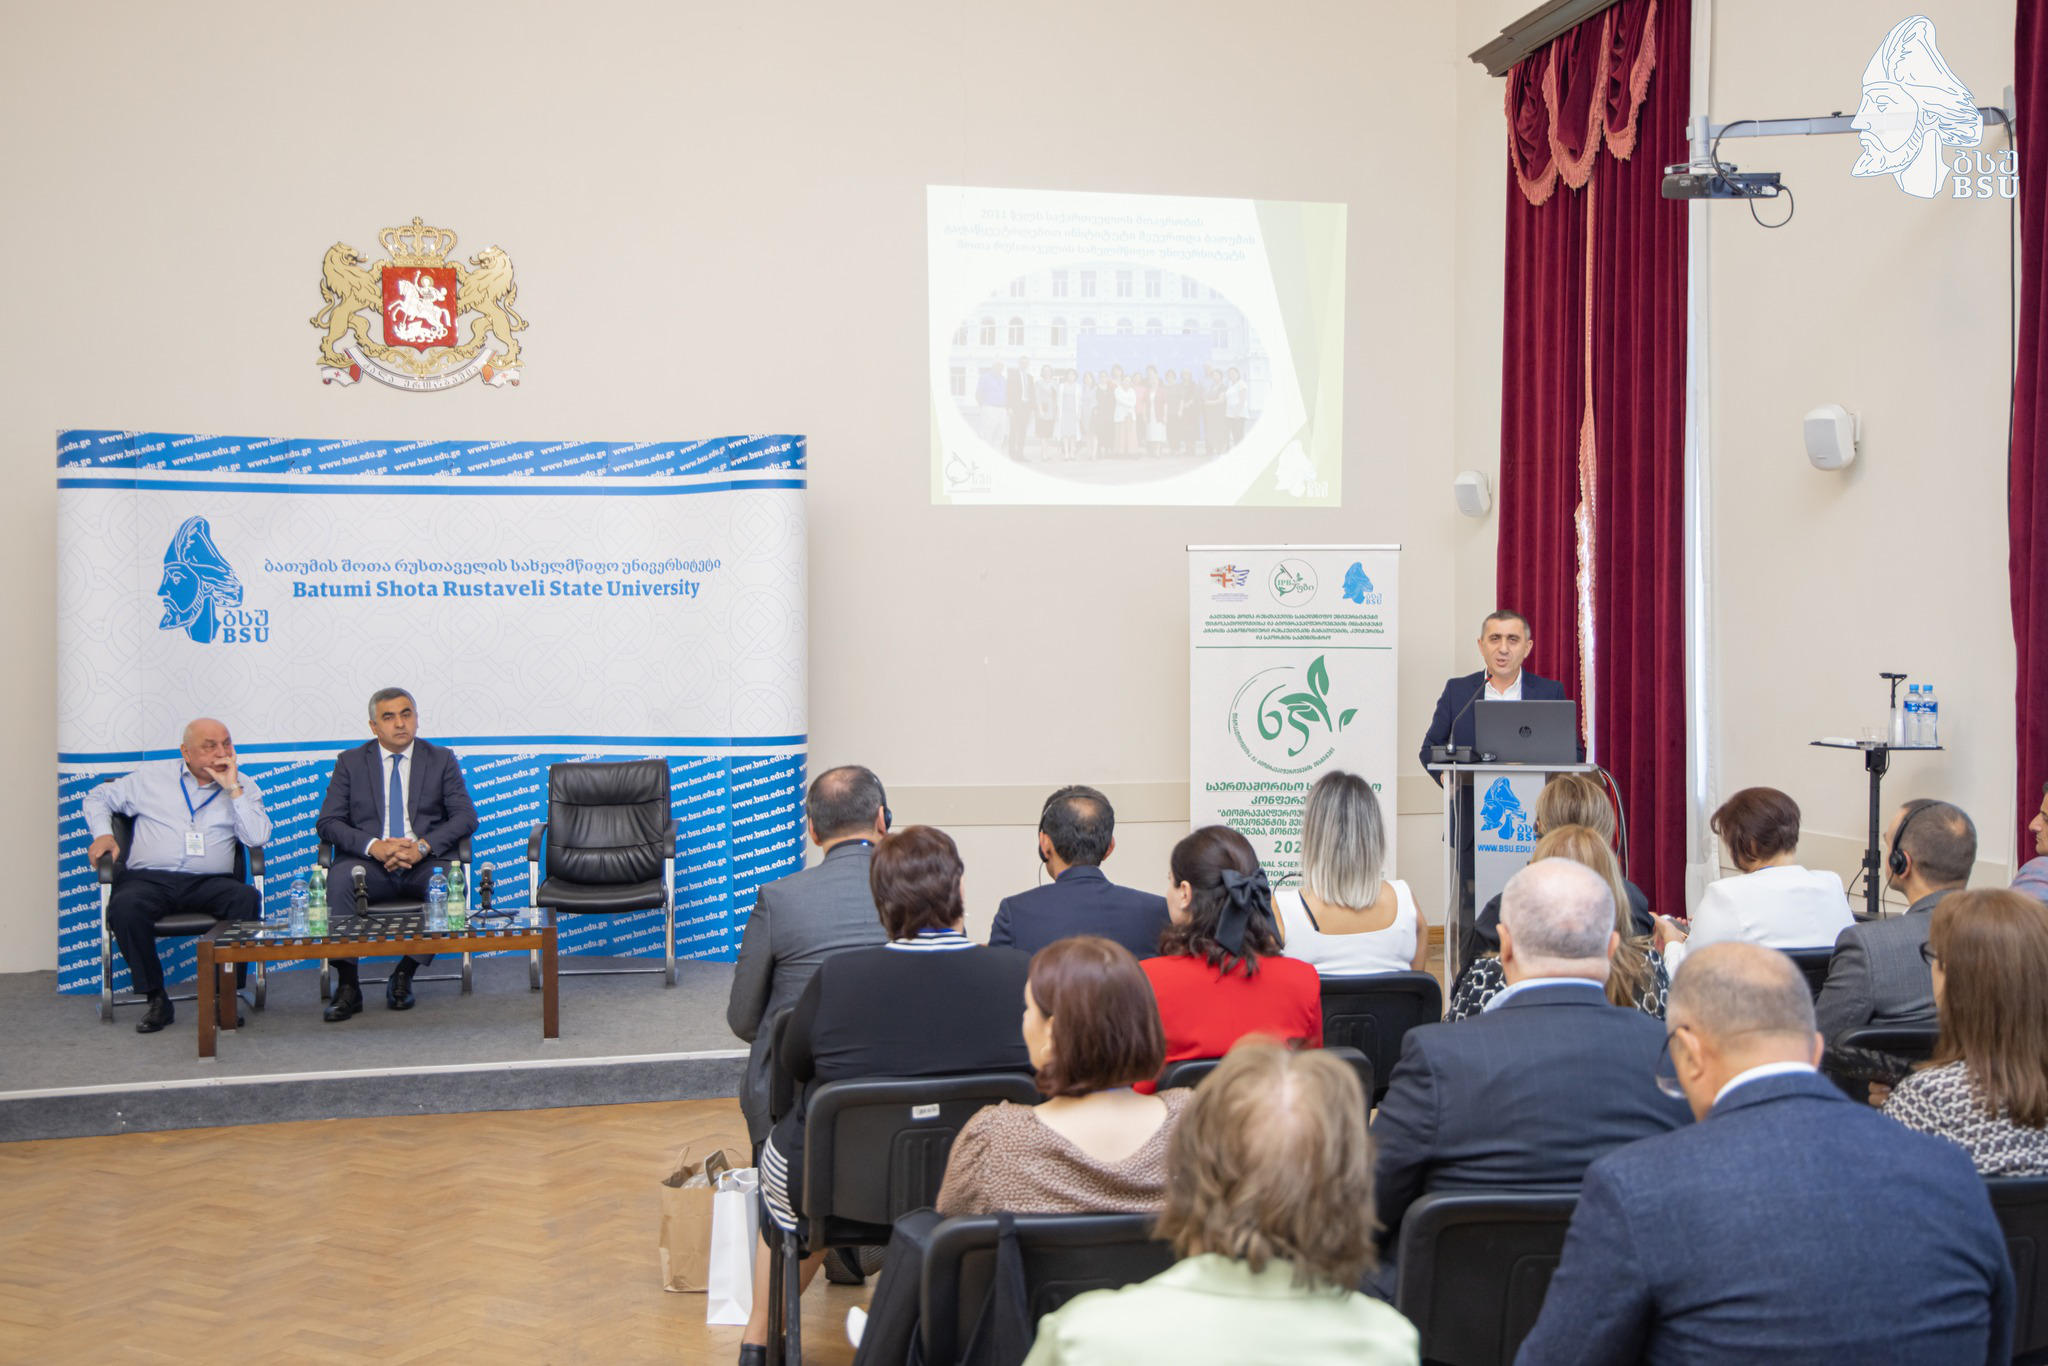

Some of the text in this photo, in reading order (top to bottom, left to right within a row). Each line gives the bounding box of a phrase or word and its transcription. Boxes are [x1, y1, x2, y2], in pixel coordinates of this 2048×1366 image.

[100, 441, 166, 464] www.bsu.edu.ge
[172, 444, 241, 466] www.bsu.edu.ge
[248, 447, 312, 468] www.bsu.edu.ge
[319, 448, 387, 471] www.bsu.edu.ge
[394, 449, 461, 472] www.bsu.edu.ge
[467, 449, 535, 472] www.bsu.edu.ge
[541, 449, 607, 472] www.bsu.edu.ge
[612, 450, 675, 473] www.bsu.edu.ge
[680, 445, 726, 472] www.bsu.edu.ge
[730, 442, 792, 466] www.bsu.edu.ge
[264, 558, 721, 575] ბათუმის შოთა რუსთაველის სახელმწიფო უნივერსიტეტი
[293, 579, 700, 599] Batumi Shota Rustaveli State University
[223, 627, 269, 643] BSU
[473, 767, 540, 791] www.bsu.edu.ge
[671, 769, 726, 791] www.bsu.edu.ge
[732, 767, 795, 792] www.bsu.edu.ge
[473, 784, 540, 807] www.bsu.edu.ge
[732, 785, 795, 809] www.bsu.edu.ge
[732, 802, 795, 827] www.bsu.edu.ge
[732, 820, 796, 845] www.bsu.edu.ge
[733, 837, 796, 862] www.bsu.edu.ge
[733, 855, 796, 880] www.bsu.edu.ge
